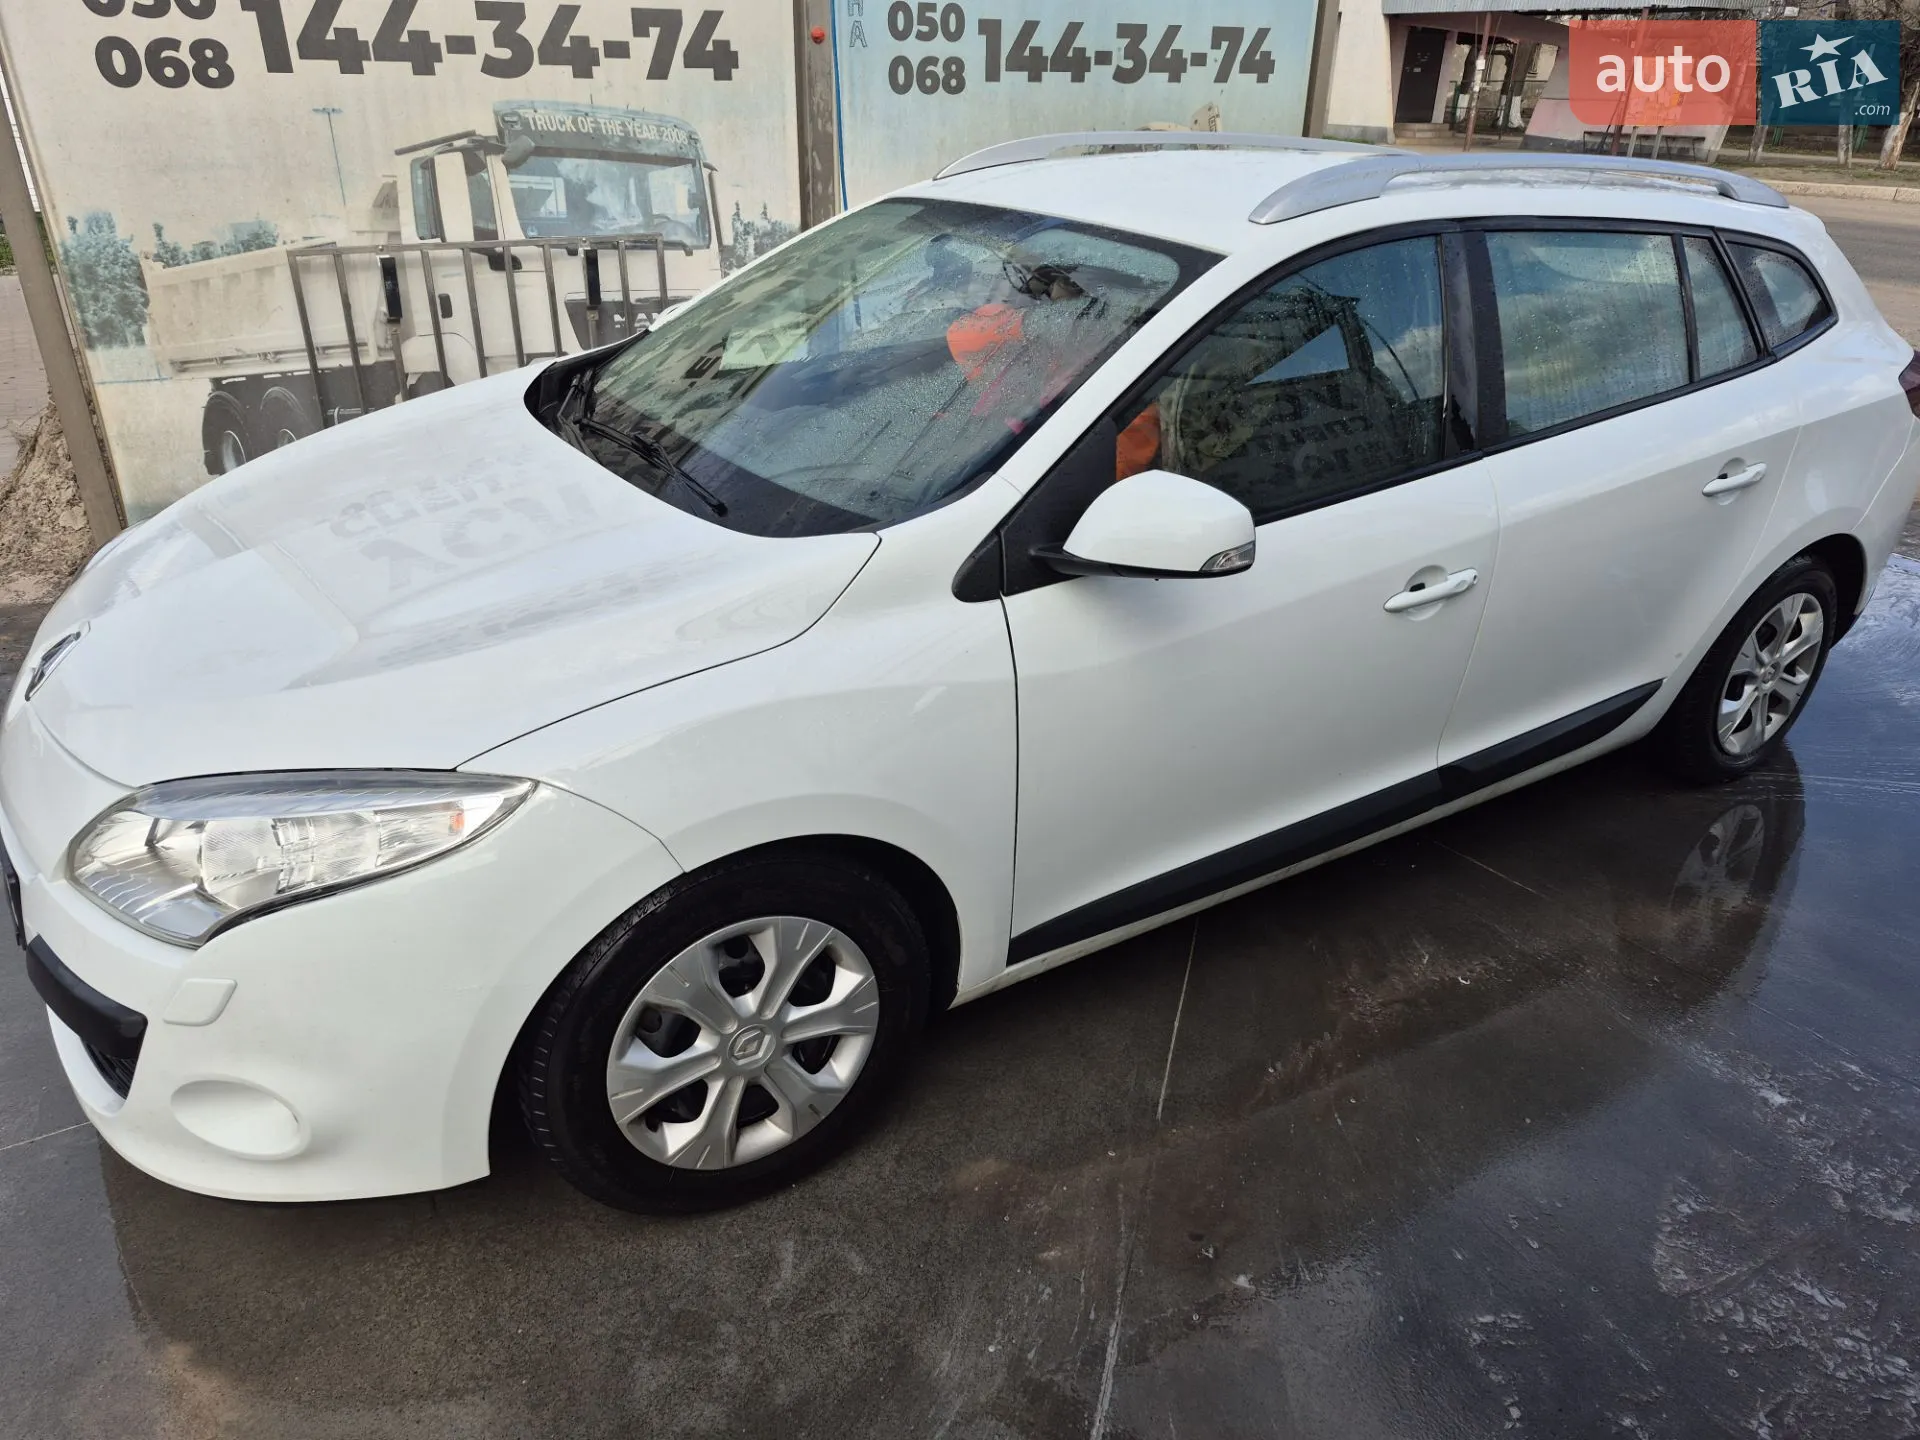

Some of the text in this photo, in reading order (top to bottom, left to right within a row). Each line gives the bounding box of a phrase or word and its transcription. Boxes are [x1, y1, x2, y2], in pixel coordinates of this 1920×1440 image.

[239, 0, 739, 81] 144-34-74
[887, 1, 966, 42] 050
[95, 35, 235, 89] 068
[977, 18, 1276, 84] 144-34-74
[888, 55, 967, 95] 068
[526, 114, 576, 133] TRUCK
[579, 117, 596, 134] OF
[599, 119, 624, 136] THE
[627, 121, 659, 140] YEAR
